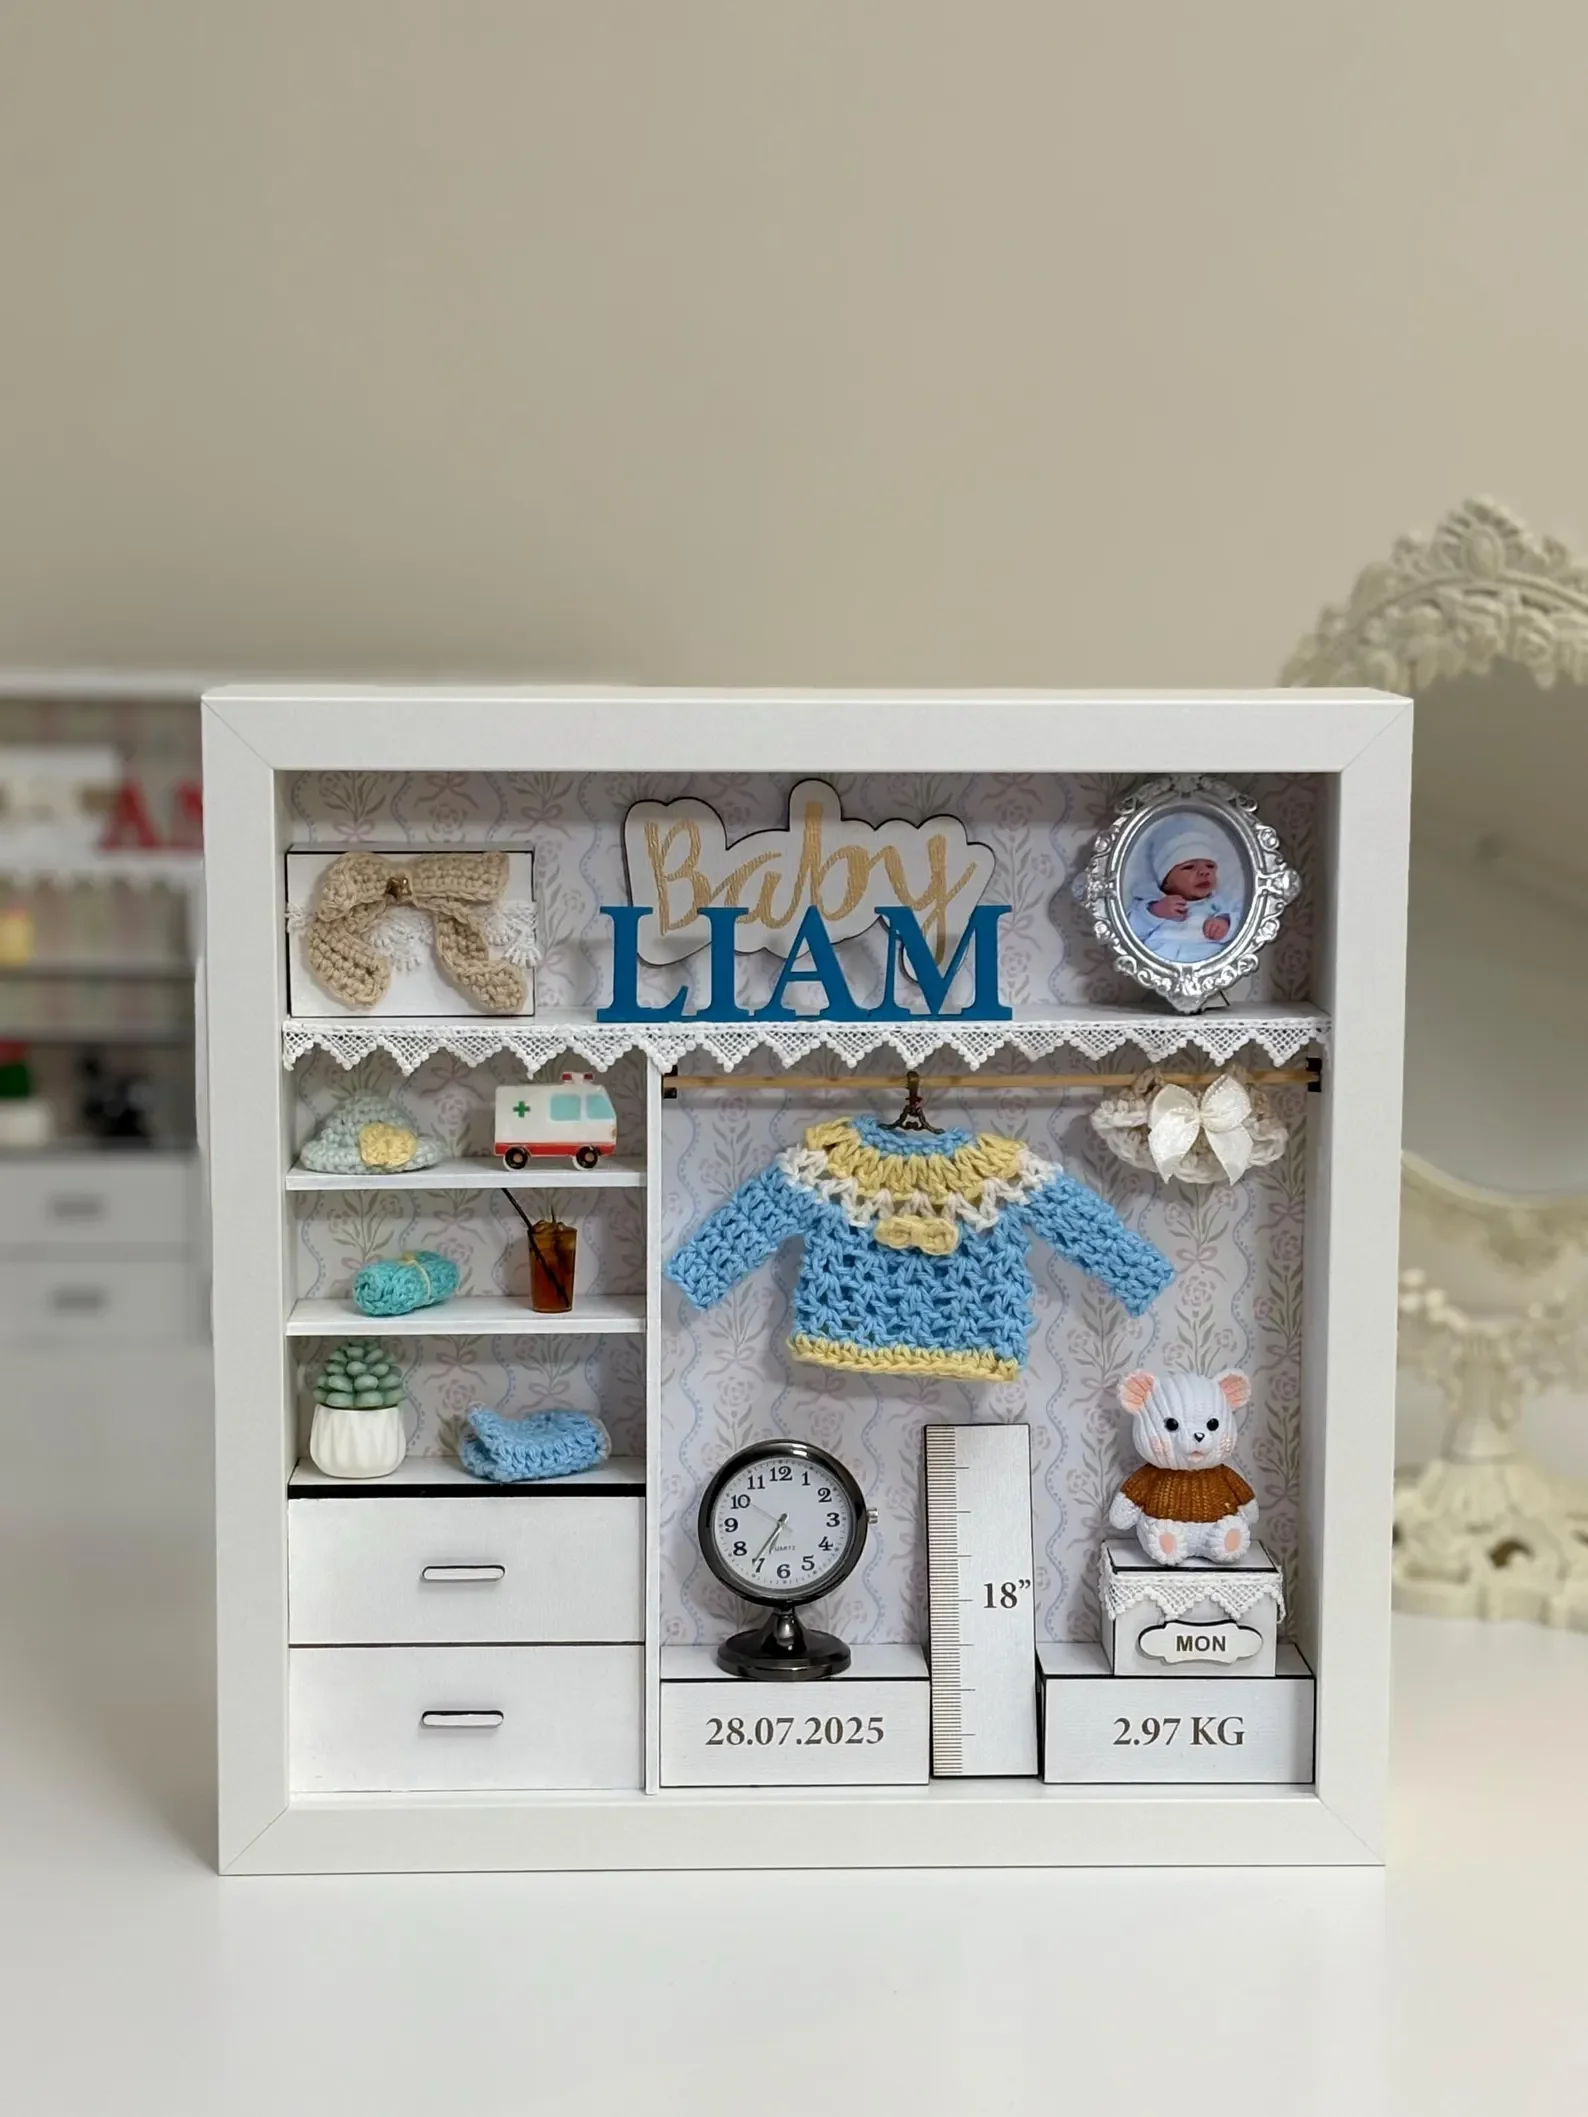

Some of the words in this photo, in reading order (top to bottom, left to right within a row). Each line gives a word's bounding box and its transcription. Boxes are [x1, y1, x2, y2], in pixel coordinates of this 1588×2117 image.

[644, 801, 978, 966] Baby
[596, 905, 1013, 1022] LIAM
[769, 1465, 793, 1482] 12
[801, 1471, 811, 1486] 1
[747, 1474, 766, 1490] 11
[730, 1494, 751, 1509] 10
[817, 1487, 832, 1503] 2
[724, 1517, 739, 1533] 9
[826, 1512, 841, 1527] 3
[733, 1540, 748, 1556] 8
[818, 1536, 834, 1551] 4
[752, 1557, 765, 1573] 7
[776, 1563, 791, 1579] 6
[801, 1555, 815, 1571] 5
[1176, 1635, 1227, 1653] MON
[705, 1716, 884, 1746] 28.07.2025
[1113, 1717, 1181, 1746] 2.97
[1191, 1716, 1245, 1746] KG
